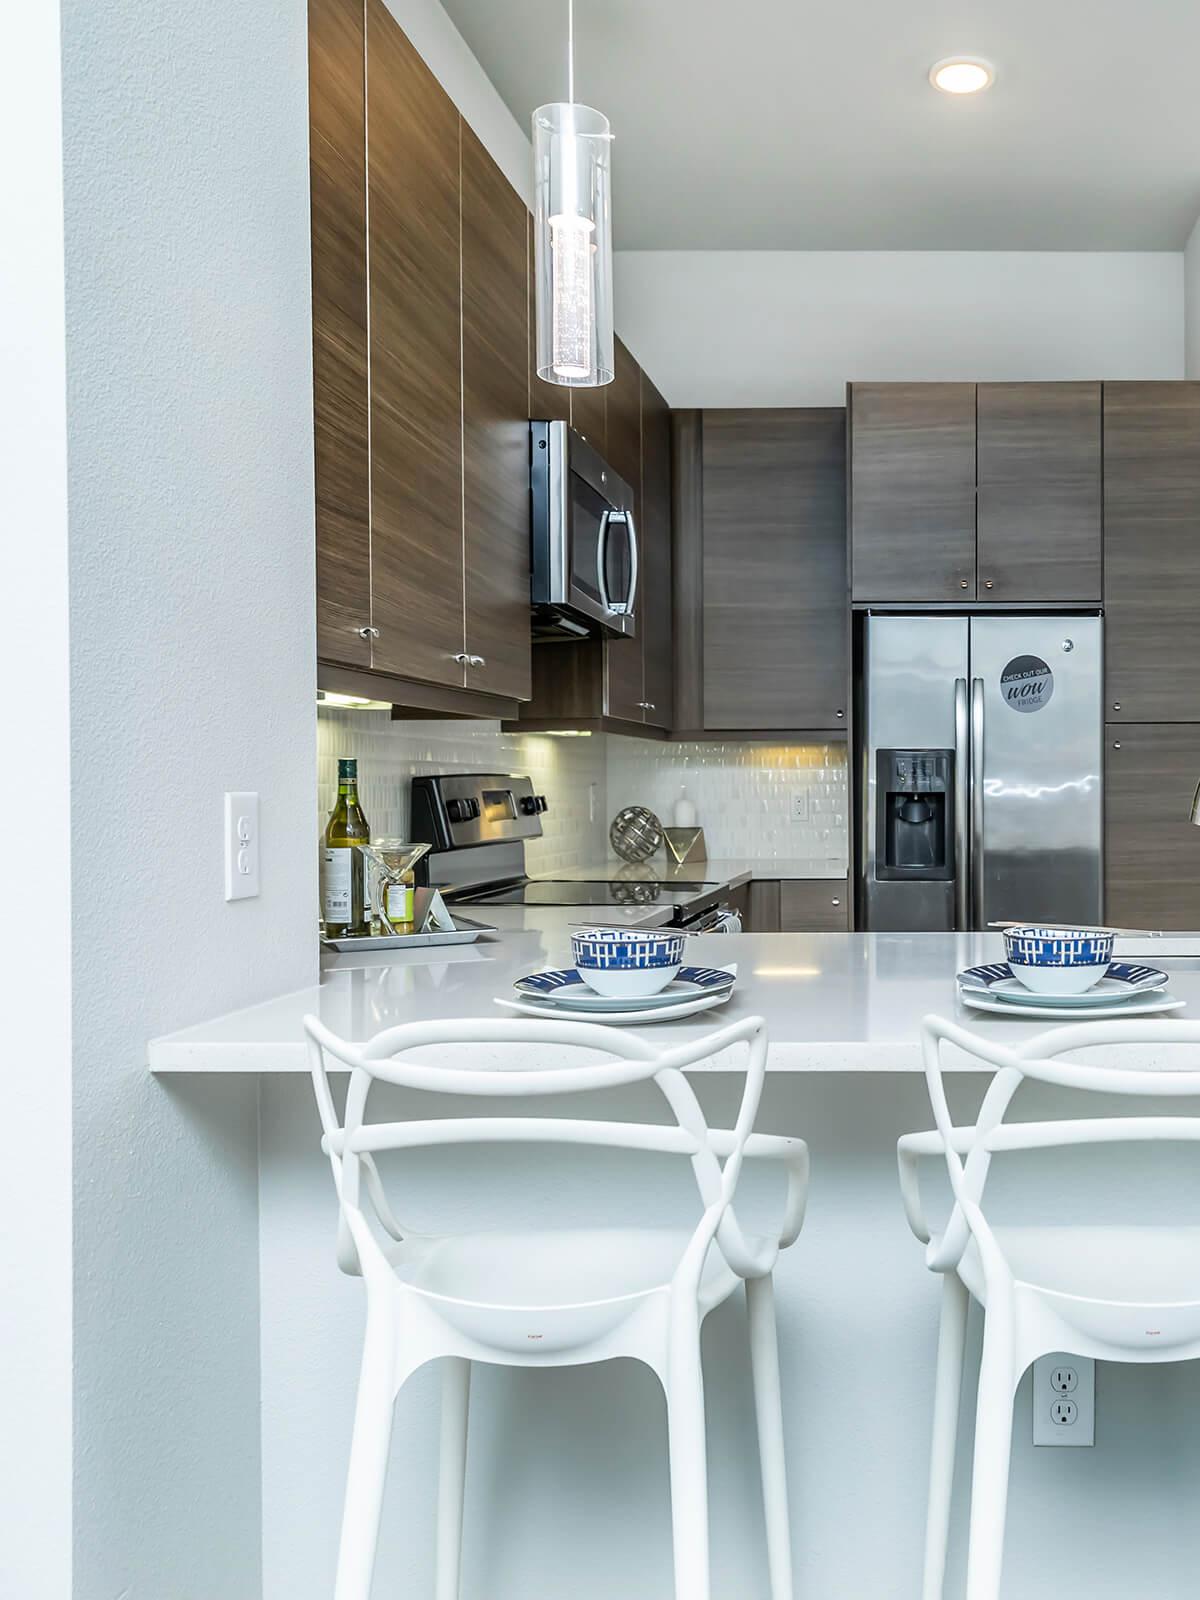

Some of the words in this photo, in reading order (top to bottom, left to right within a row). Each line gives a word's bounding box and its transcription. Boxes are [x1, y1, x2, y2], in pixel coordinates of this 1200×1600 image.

[1003, 673, 1022, 681] CHECK
[1008, 678, 1048, 700] wow
[1018, 696, 1043, 706] FRIDGE
